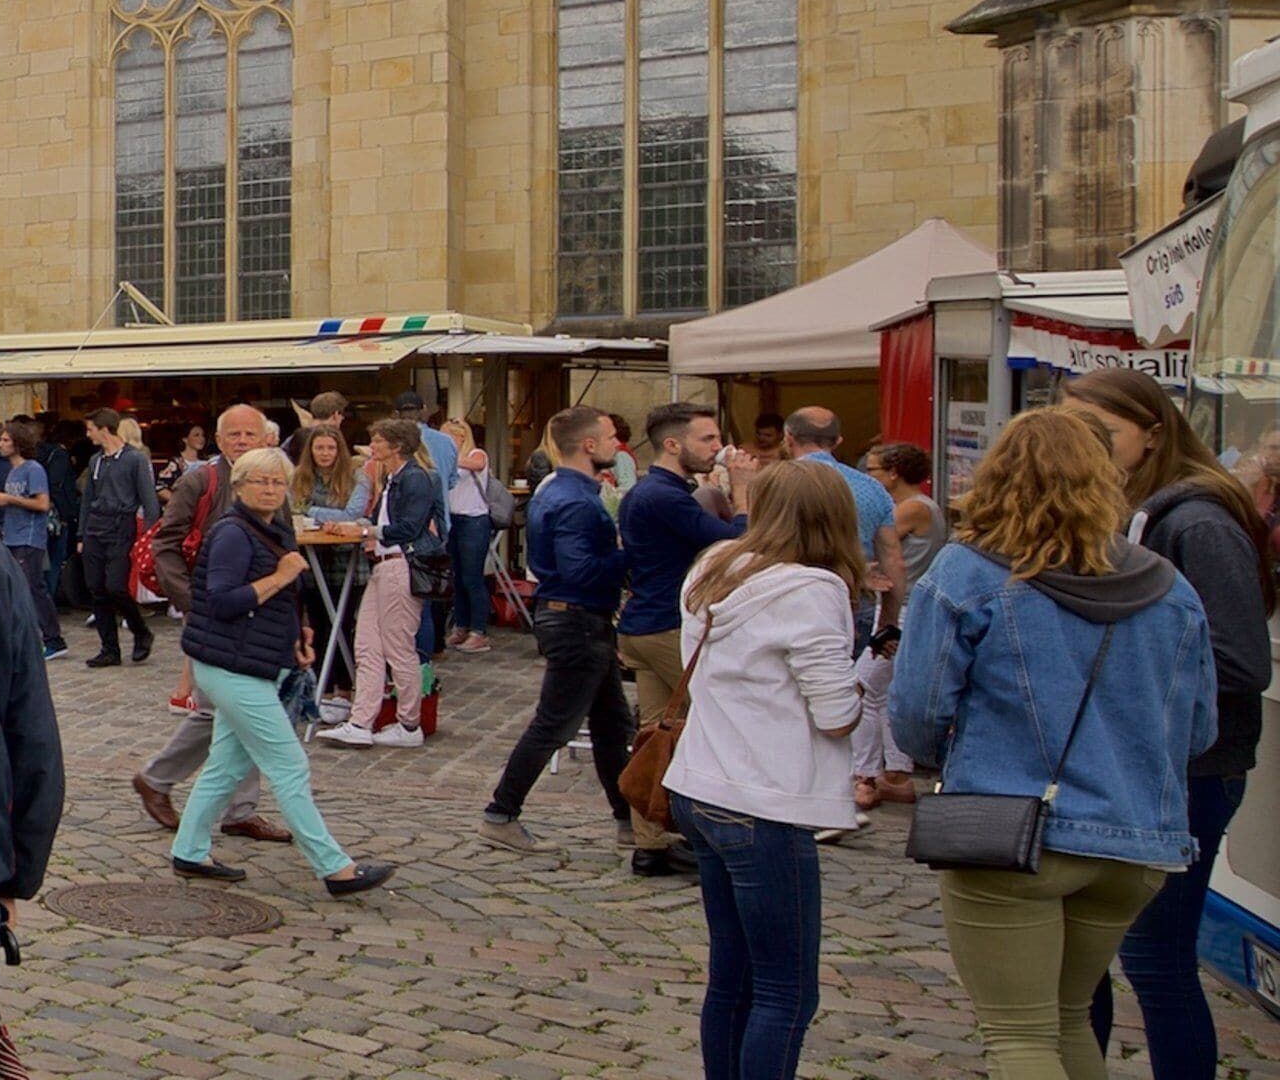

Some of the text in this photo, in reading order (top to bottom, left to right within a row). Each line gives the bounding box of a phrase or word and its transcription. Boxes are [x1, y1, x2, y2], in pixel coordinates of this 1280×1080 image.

[1146, 239, 1185, 275] Original
[1164, 283, 1184, 309] süß
[1254, 950, 1276, 996] MS
